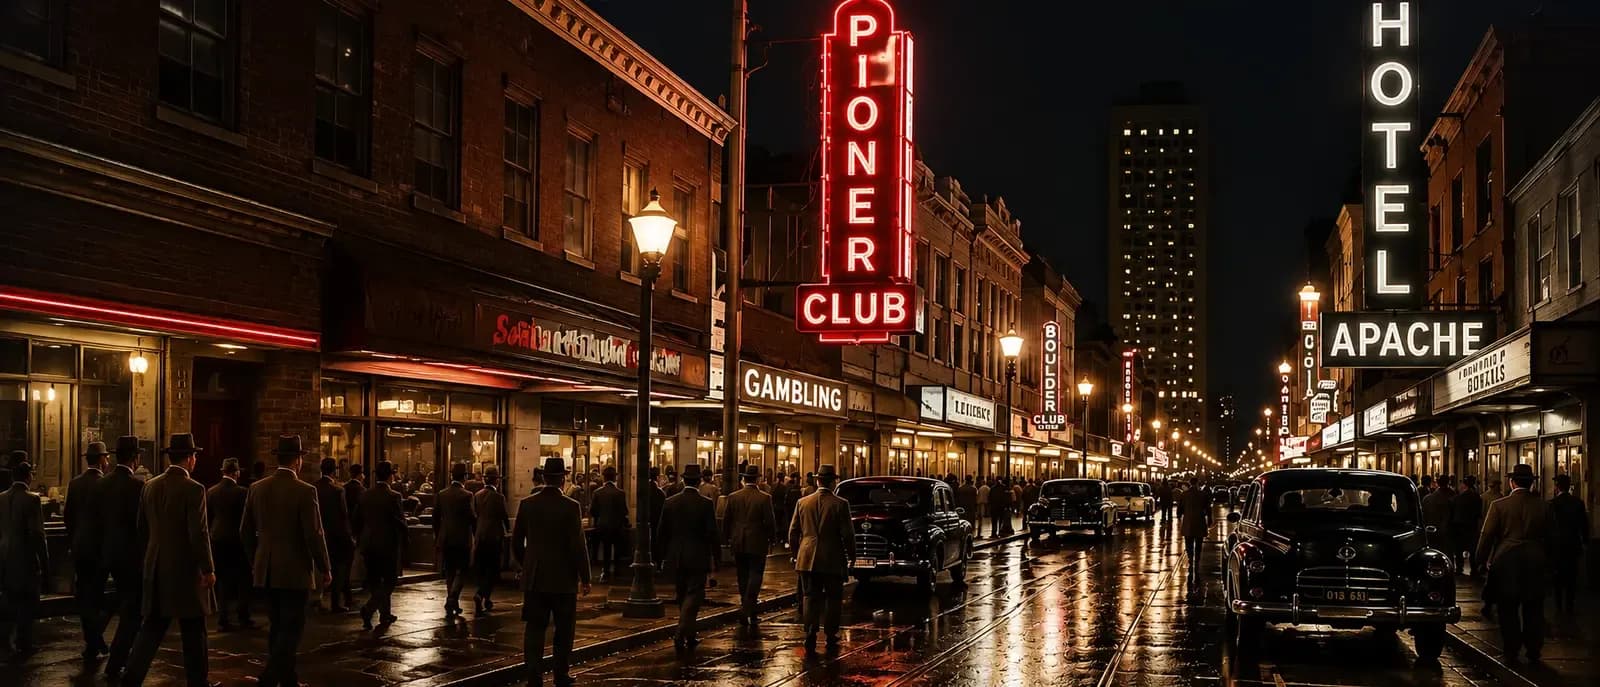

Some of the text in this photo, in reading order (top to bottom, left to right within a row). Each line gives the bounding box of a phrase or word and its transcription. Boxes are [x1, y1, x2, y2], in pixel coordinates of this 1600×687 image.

[846, 15, 878, 272] PIONER
[1371, 2, 1412, 293] HOTEL
[803, 292, 906, 324] CLUB
[1330, 322, 1483, 357] APACHE
[744, 368, 842, 412] GAMBLING
[1045, 325, 1056, 411] BOULDER
[1033, 414, 1065, 424] CLUB
